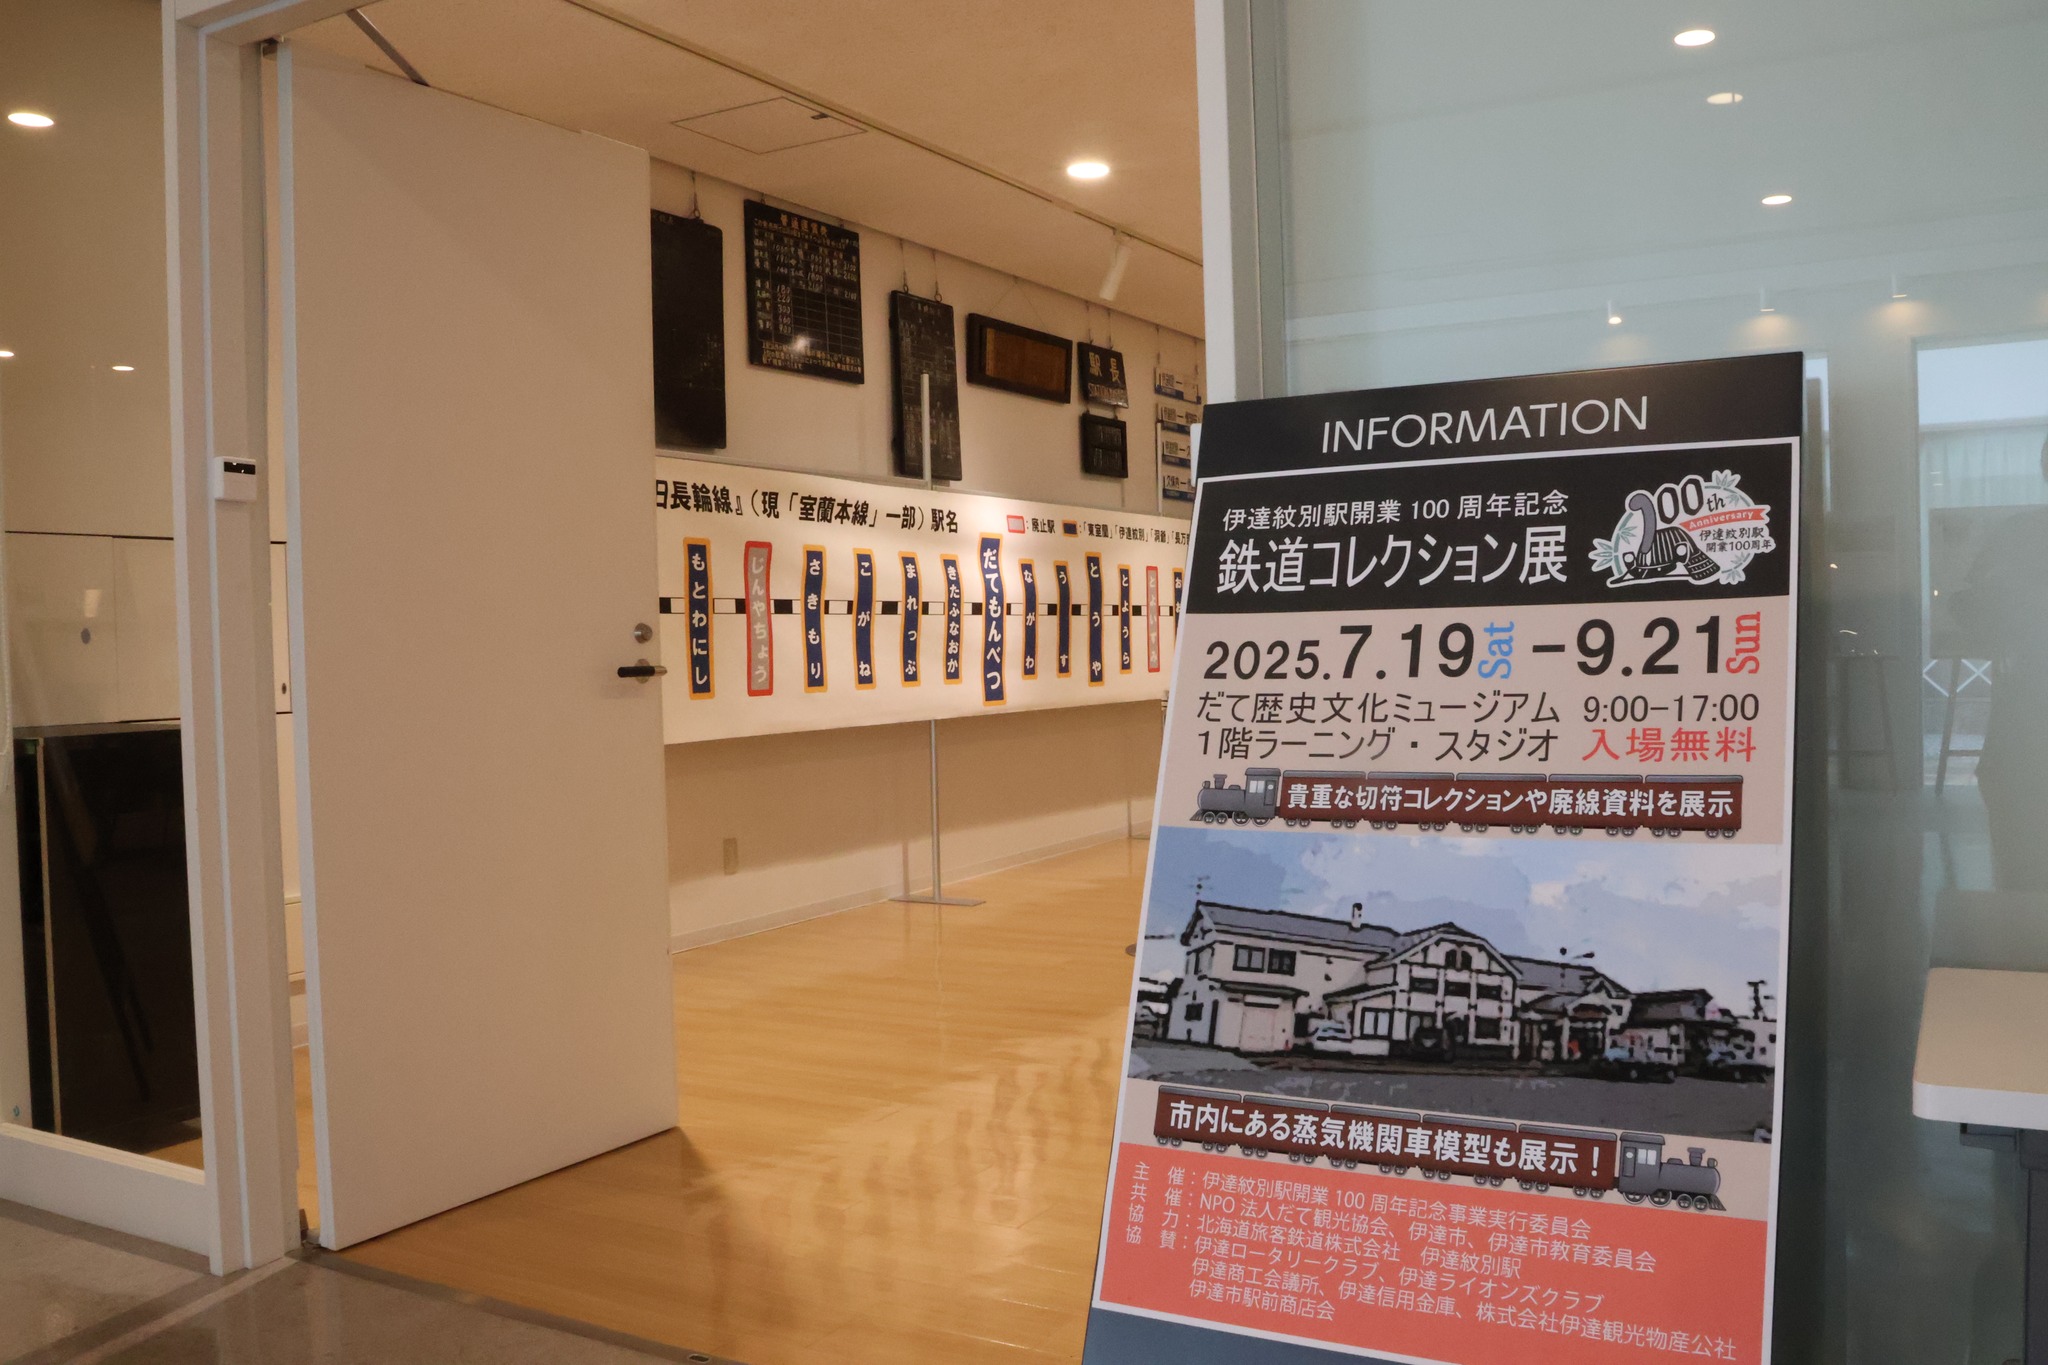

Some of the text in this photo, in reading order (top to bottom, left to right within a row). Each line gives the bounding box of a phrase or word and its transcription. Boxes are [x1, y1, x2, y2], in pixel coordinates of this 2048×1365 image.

[1089, 353, 1121, 384] 駅長
[1321, 395, 1649, 454] INFORMATION
[1222, 488, 1569, 532] 伊達紋別駅開業 100 周年記念
[1687, 509, 1755, 530] Anniversary
[1699, 527, 1765, 542] 伊達紋別駅
[1217, 525, 1569, 595] 鉄道コレクション展
[1705, 538, 1773, 553] 開業100周年
[691, 553, 708, 688] もとわにし
[750, 556, 768, 684] じんやちょう
[807, 558, 822, 681] さきもり
[858, 561, 872, 678] こがね
[905, 564, 918, 675] まれっぷ
[948, 566, 960, 673] きたふなおか
[983, 548, 1002, 693] だてもんべつ
[1024, 570, 1035, 670] ながわ
[1058, 573, 1069, 664] うす
[1090, 561, 1102, 677] とうや
[1121, 574, 1131, 665] とようら
[1203, 623, 1475, 682] 2025.7.19
[1478, 621, 1514, 680] Sat
[1726, 611, 1760, 674] Sun
[1197, 690, 1561, 725] だて歴史文化ミュージアム
[1582, 727, 1757, 763] 入場無料
[1287, 783, 1734, 819] 貴重な切符コレクションや廃線資料を展示
[1168, 1099, 1600, 1178] 市内にある蒸気機関車模型も展示！
[1335, 1189, 1365, 1210] 100
[1371, 1193, 1591, 1240] 周年記念事業実行委員会
[1420, 1246, 1520, 1279] 伊達紋別駅
[1189, 1277, 1335, 1321] 伊達市駅前商店会
